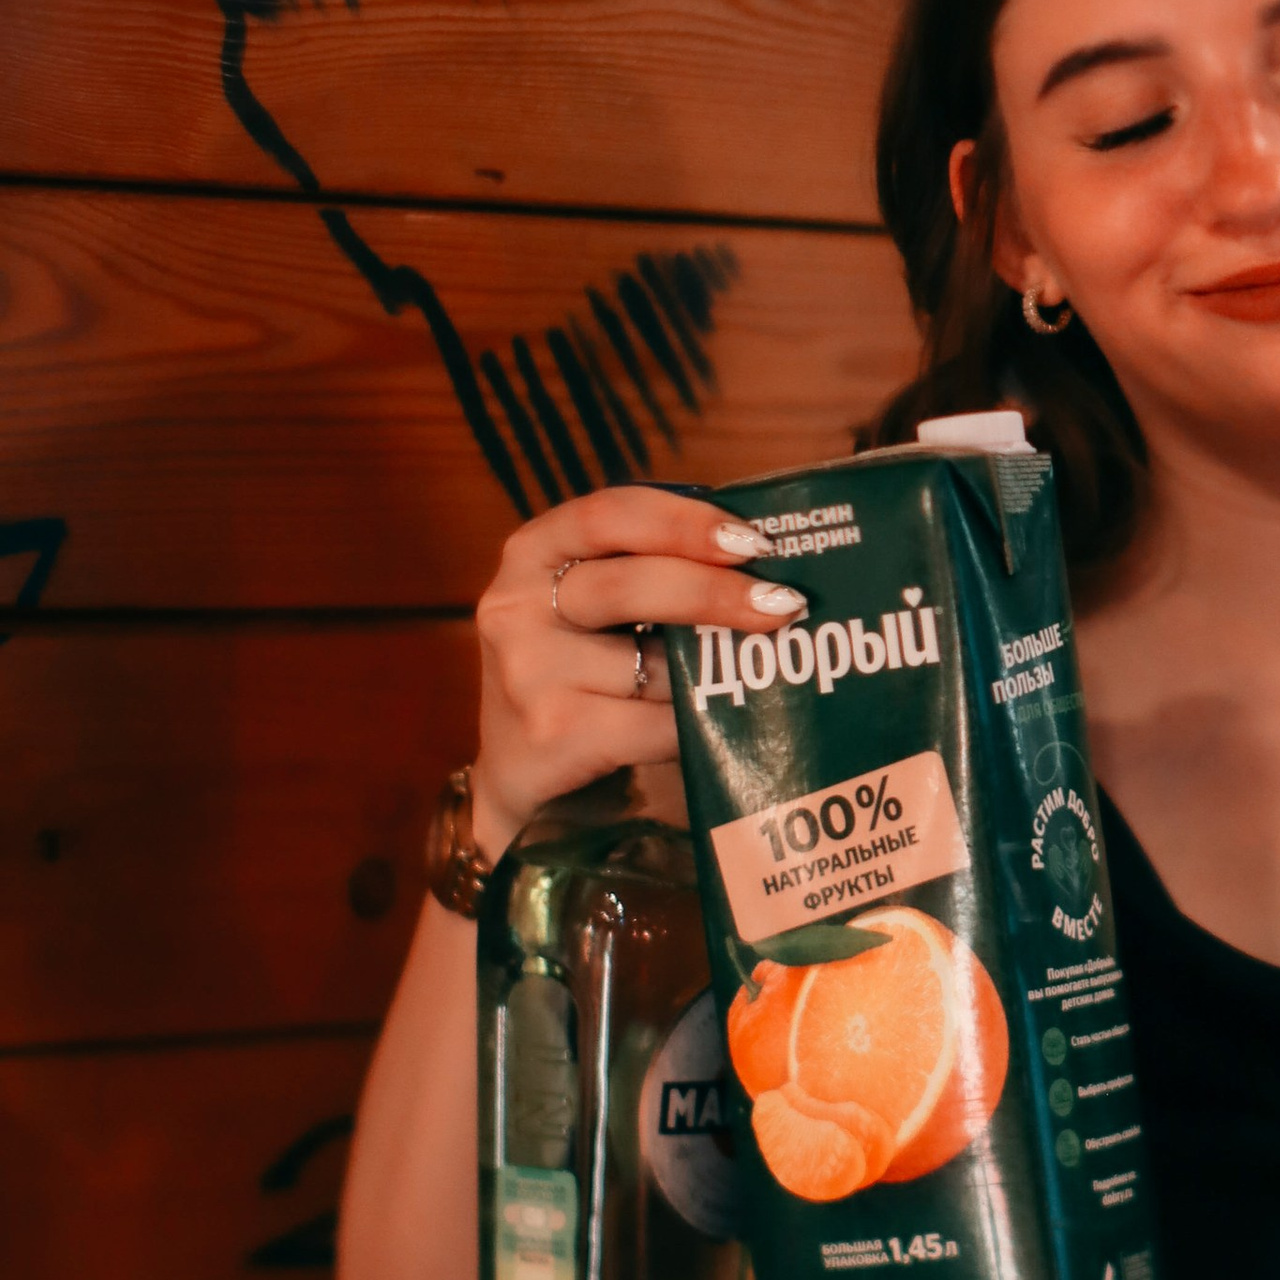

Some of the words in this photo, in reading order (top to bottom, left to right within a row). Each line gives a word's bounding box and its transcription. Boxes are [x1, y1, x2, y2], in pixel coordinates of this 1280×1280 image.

[750, 504, 854, 536] пельсин
[757, 526, 861, 558] ндарин
[694, 587, 941, 711] Добрый
[1001, 623, 1064, 669] БОЛЬШЕ
[992, 662, 1055, 705] ПОЛЬЗЫ
[760, 774, 903, 863] 100%
[1031, 786, 1065, 870] РАСТИМ
[1067, 788, 1100, 862] ДОБРО
[762, 825, 920, 896] НАТУРАЛЬНЫЕ
[803, 865, 895, 910] ФРУКТЫ
[1051, 892, 1103, 941] ВМЕСТЕ
[1027, 987, 1044, 1001] вы
[821, 1239, 883, 1256] БОЛЬШАЯ
[823, 1251, 890, 1269] УПАКОВКА
[889, 1232, 943, 1265] 1,45
[944, 1239, 959, 1258] л
